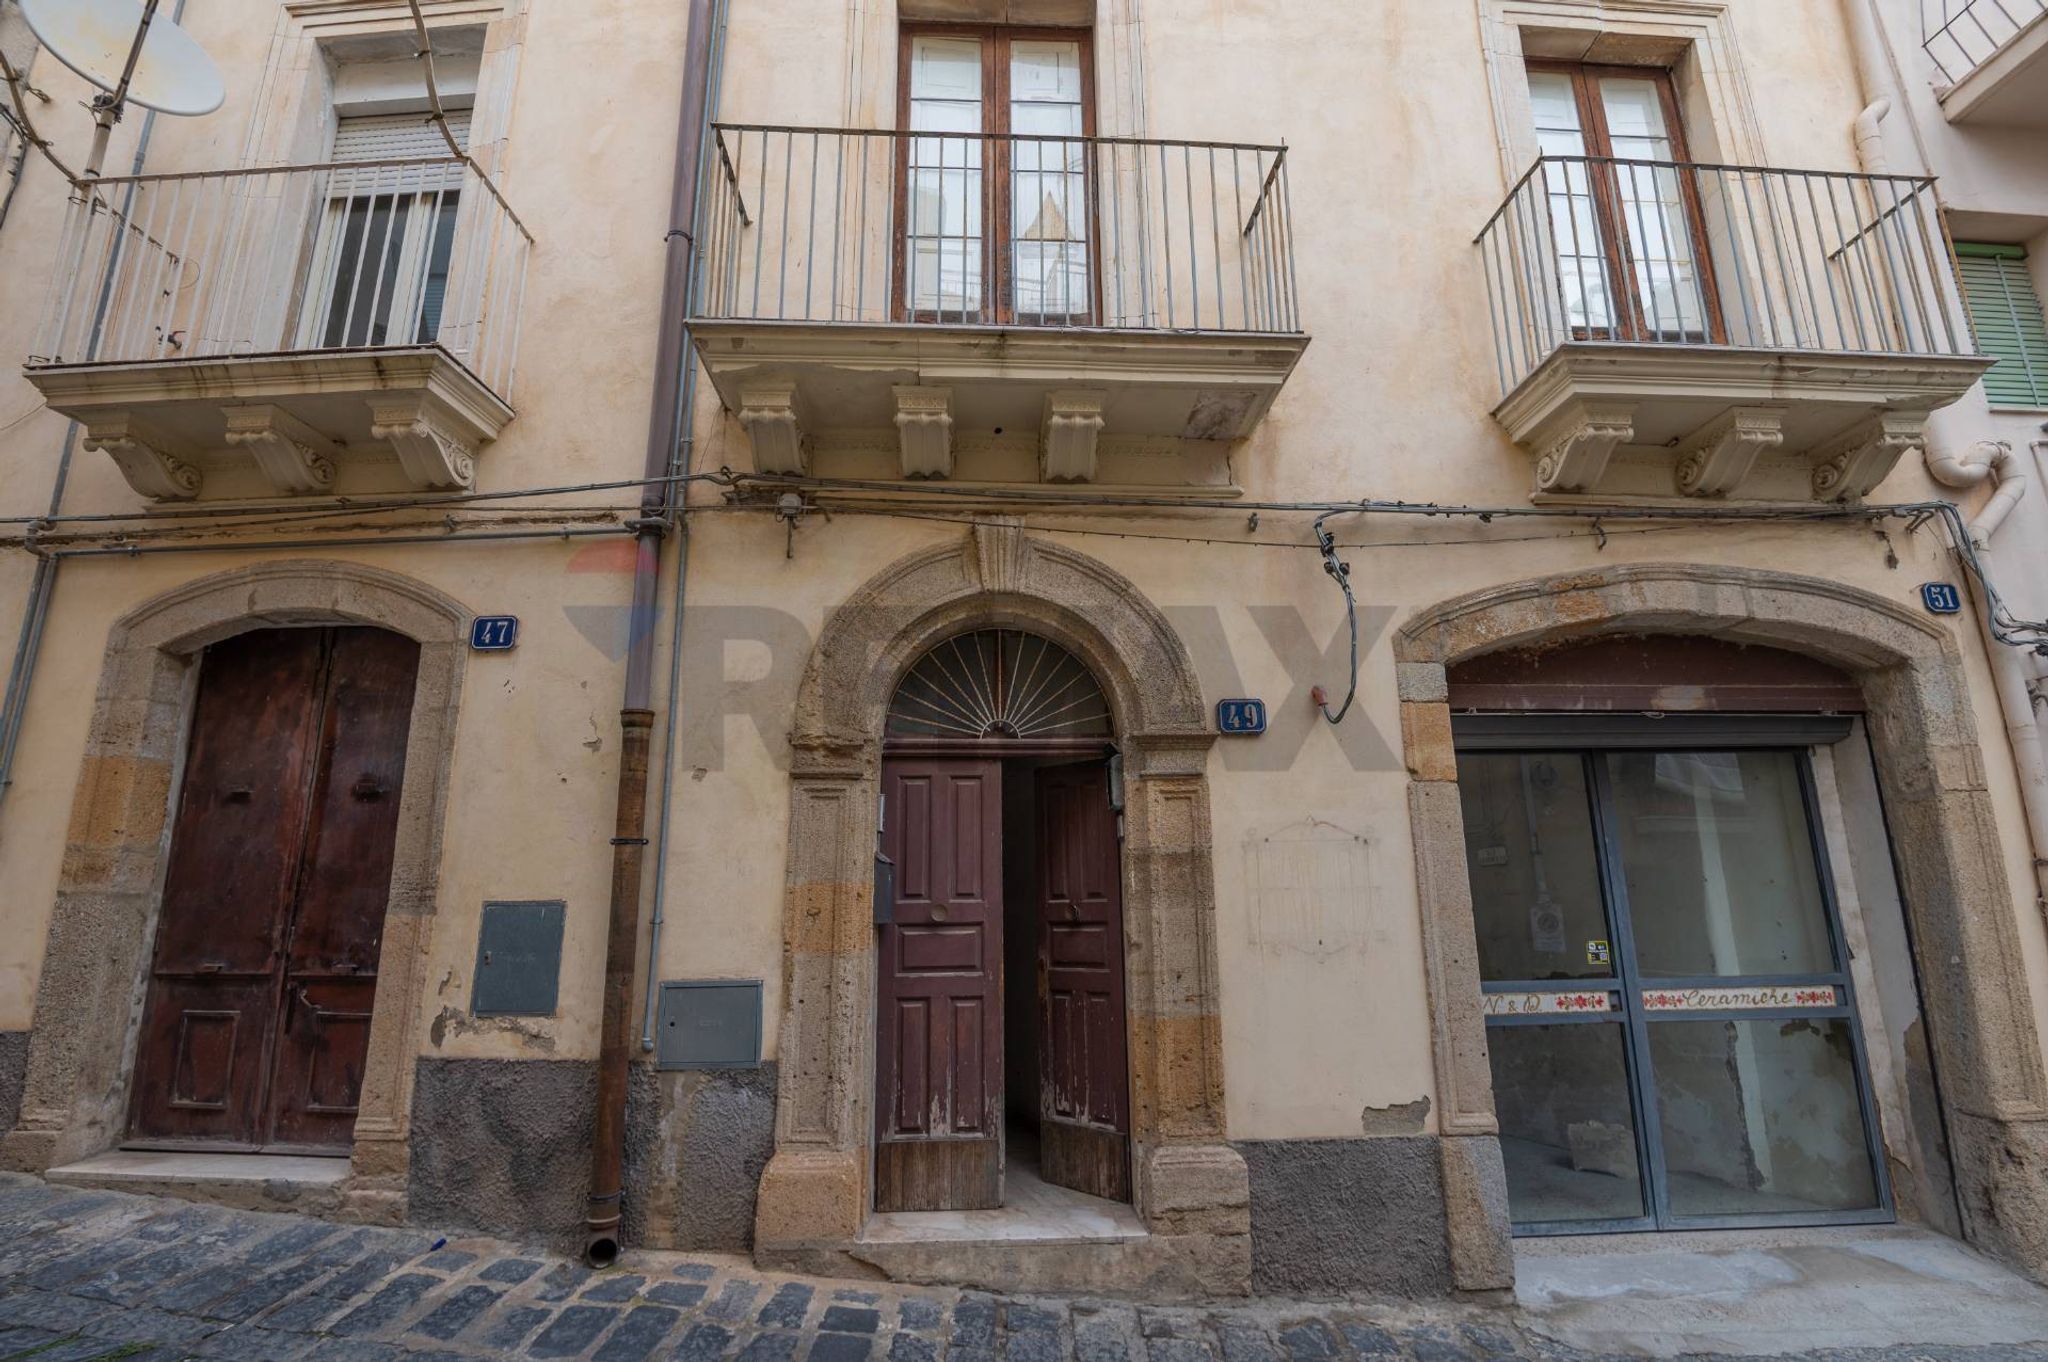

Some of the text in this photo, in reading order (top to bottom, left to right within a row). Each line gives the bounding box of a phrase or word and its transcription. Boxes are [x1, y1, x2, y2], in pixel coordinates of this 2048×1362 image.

[1930, 586, 1955, 608] 51
[480, 621, 509, 644] 47
[1228, 703, 1258, 728] 49
[1682, 987, 1791, 1008] Ceramiche
